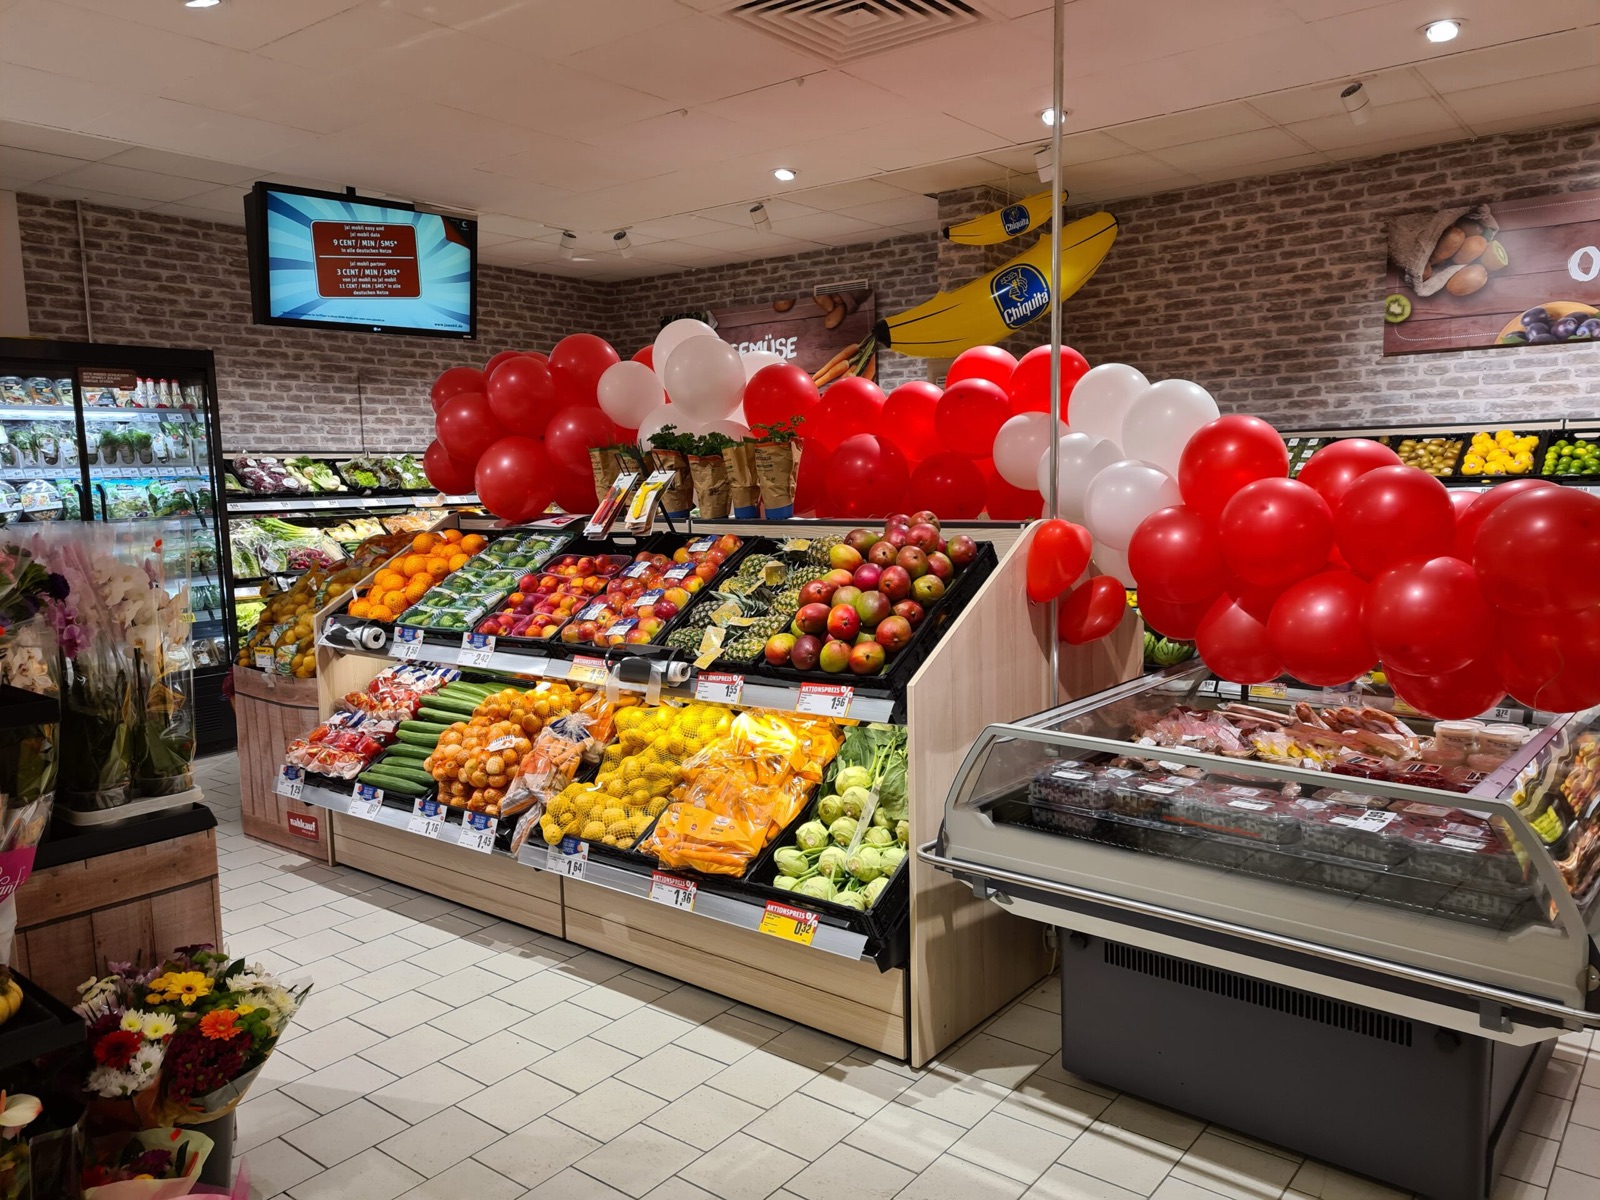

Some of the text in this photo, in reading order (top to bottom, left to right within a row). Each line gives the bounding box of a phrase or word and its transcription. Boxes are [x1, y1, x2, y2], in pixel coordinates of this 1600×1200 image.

[1005, 218, 1029, 232] Chiquita
[1567, 245, 1600, 282] O
[1003, 291, 1049, 324] Chiquita
[473, 653, 490, 665] 2.42
[726, 685, 738, 697] 1.55
[840, 686, 854, 698] %
[832, 697, 846, 710] 1.56
[1496, 709, 1508, 717] 3.72
[290, 818, 316, 832] nahkauf
[424, 822, 440, 834] 1.16
[477, 835, 492, 849] 1.45
[566, 860, 582, 875] 1.64
[652, 874, 697, 894] AKTIONSPREIS %
[674, 889, 692, 906] 1.36
[766, 904, 806, 920] AKTIONSPREIS
[806, 912, 818, 928] %
[794, 921, 812, 936] 0.32
